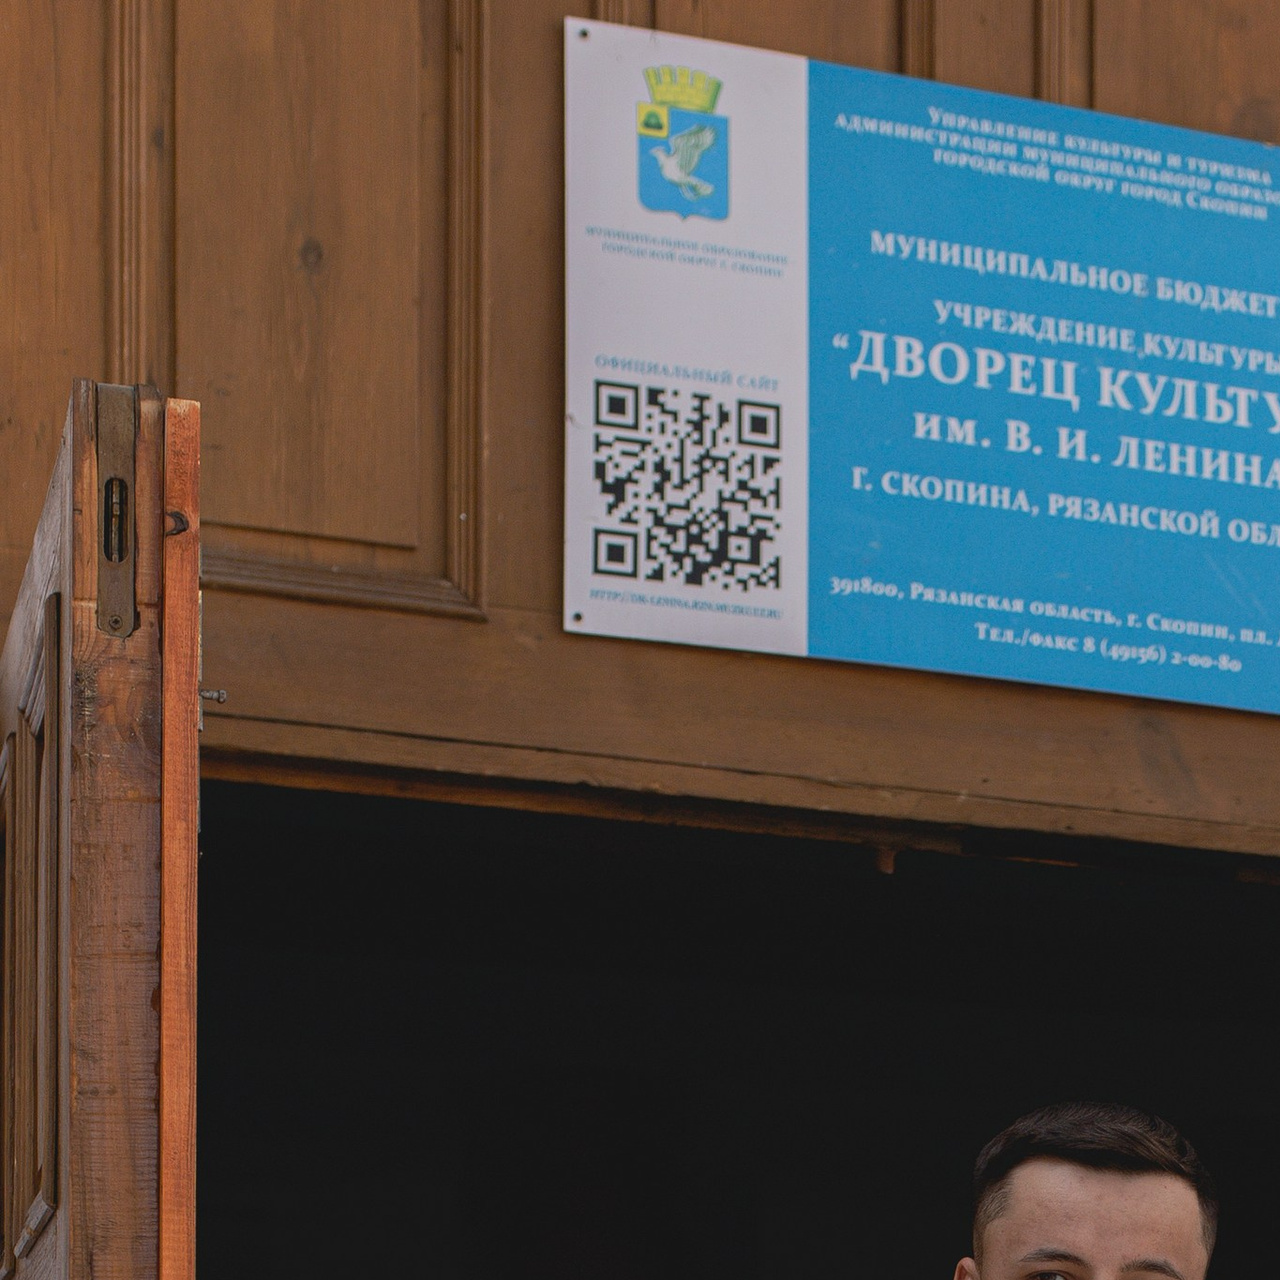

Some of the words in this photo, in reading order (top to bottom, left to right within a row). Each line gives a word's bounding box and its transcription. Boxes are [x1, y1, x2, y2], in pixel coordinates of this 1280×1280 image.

[870, 230, 1149, 297] МУНИЦИПАЛЬНОЕ
[934, 299, 1136, 353] УЧРЕЖДЕНИЕ
[1006, 419, 1042, 455] В.
[1058, 426, 1101, 463] И.
[881, 470, 1040, 516] СКОПИНА,
[1048, 492, 1220, 538] РЯЗАНСКОЙ
[830, 576, 905, 600] 391800,
[909, 581, 1024, 613] РЯЗАНСКАЯ
[1082, 636, 1096, 653] 8
[1099, 638, 1167, 664] (49156)
[1170, 651, 1243, 673] 2-00-80
